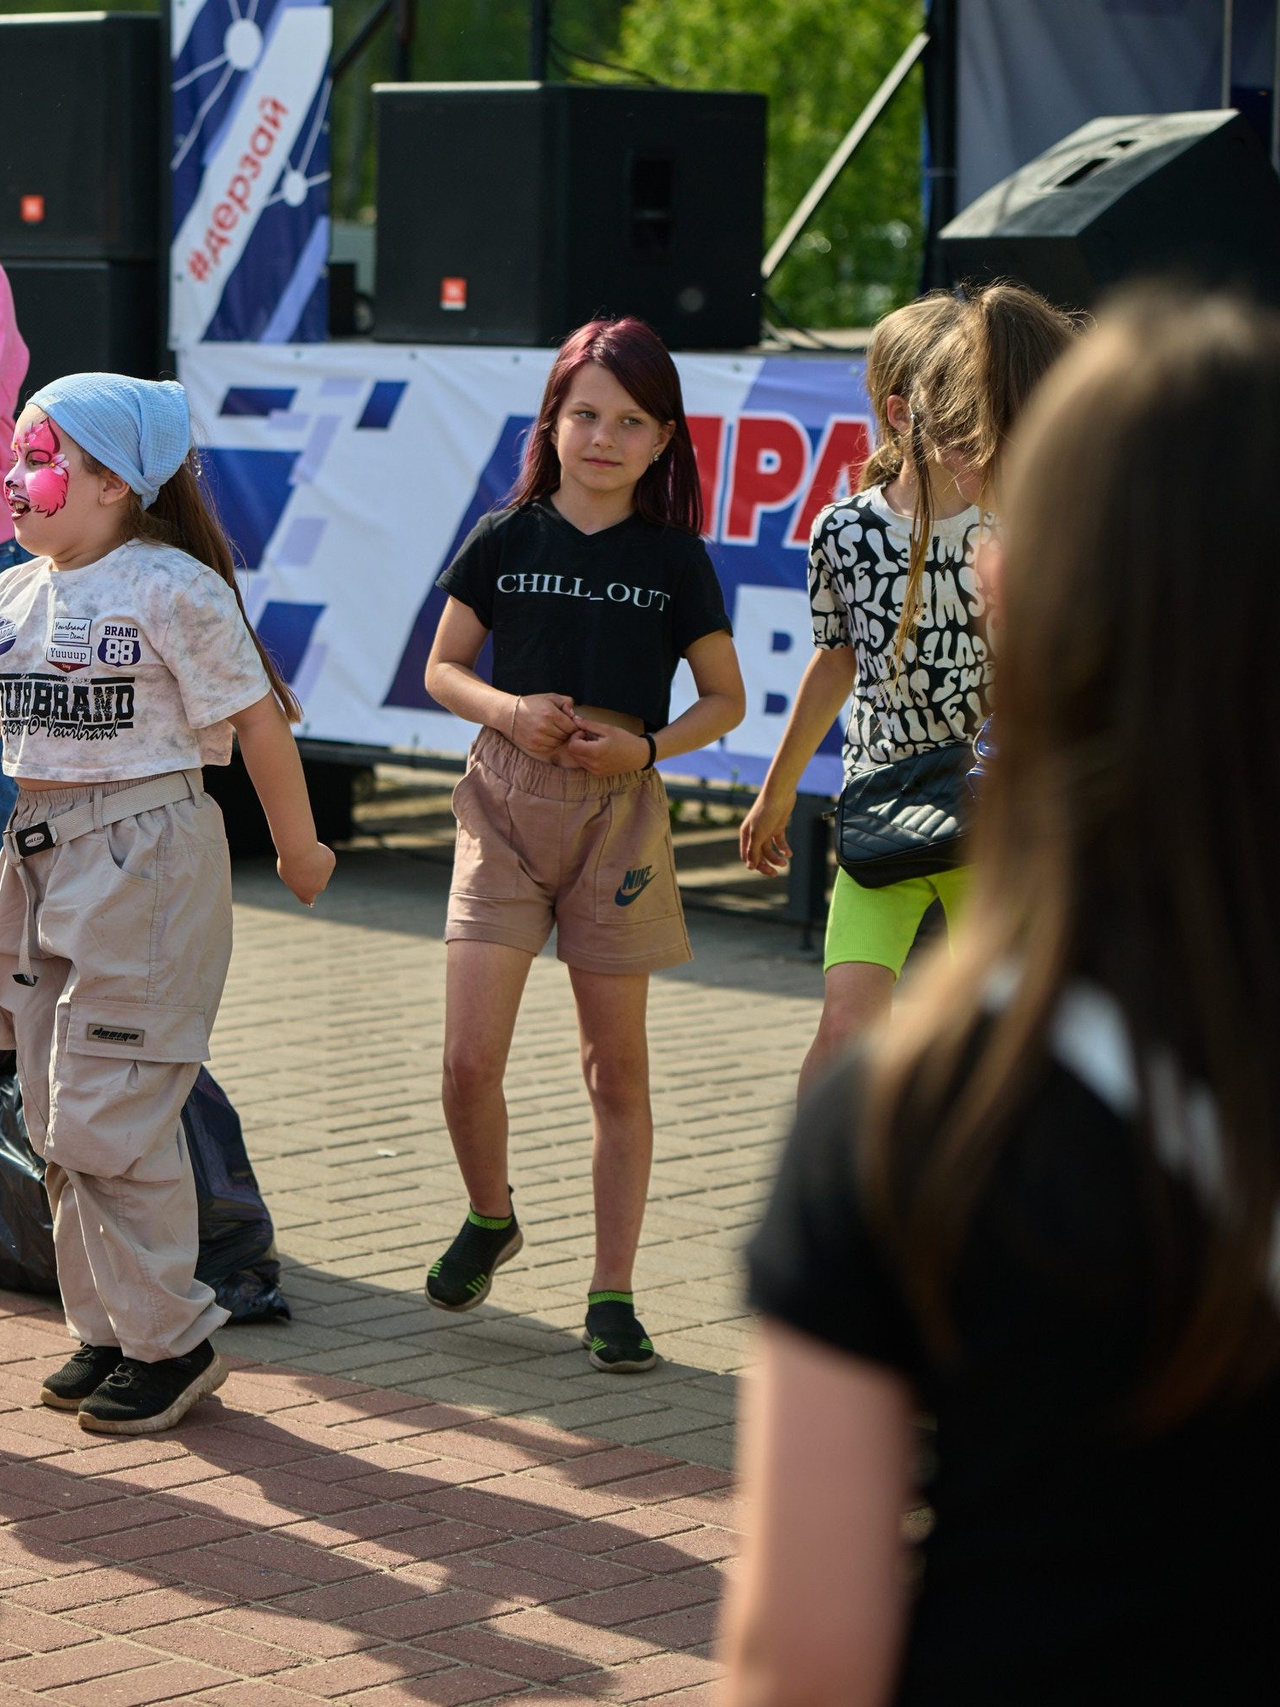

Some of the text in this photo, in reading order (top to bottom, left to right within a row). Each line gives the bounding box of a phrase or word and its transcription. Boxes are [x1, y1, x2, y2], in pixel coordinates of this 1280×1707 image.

[187, 96, 290, 283] #дерзай
[104, 625, 138, 639] BRAND
[50, 647, 87, 661] Yuuuup
[105, 639, 135, 665] 88
[919, 630, 987, 669] CUTE
